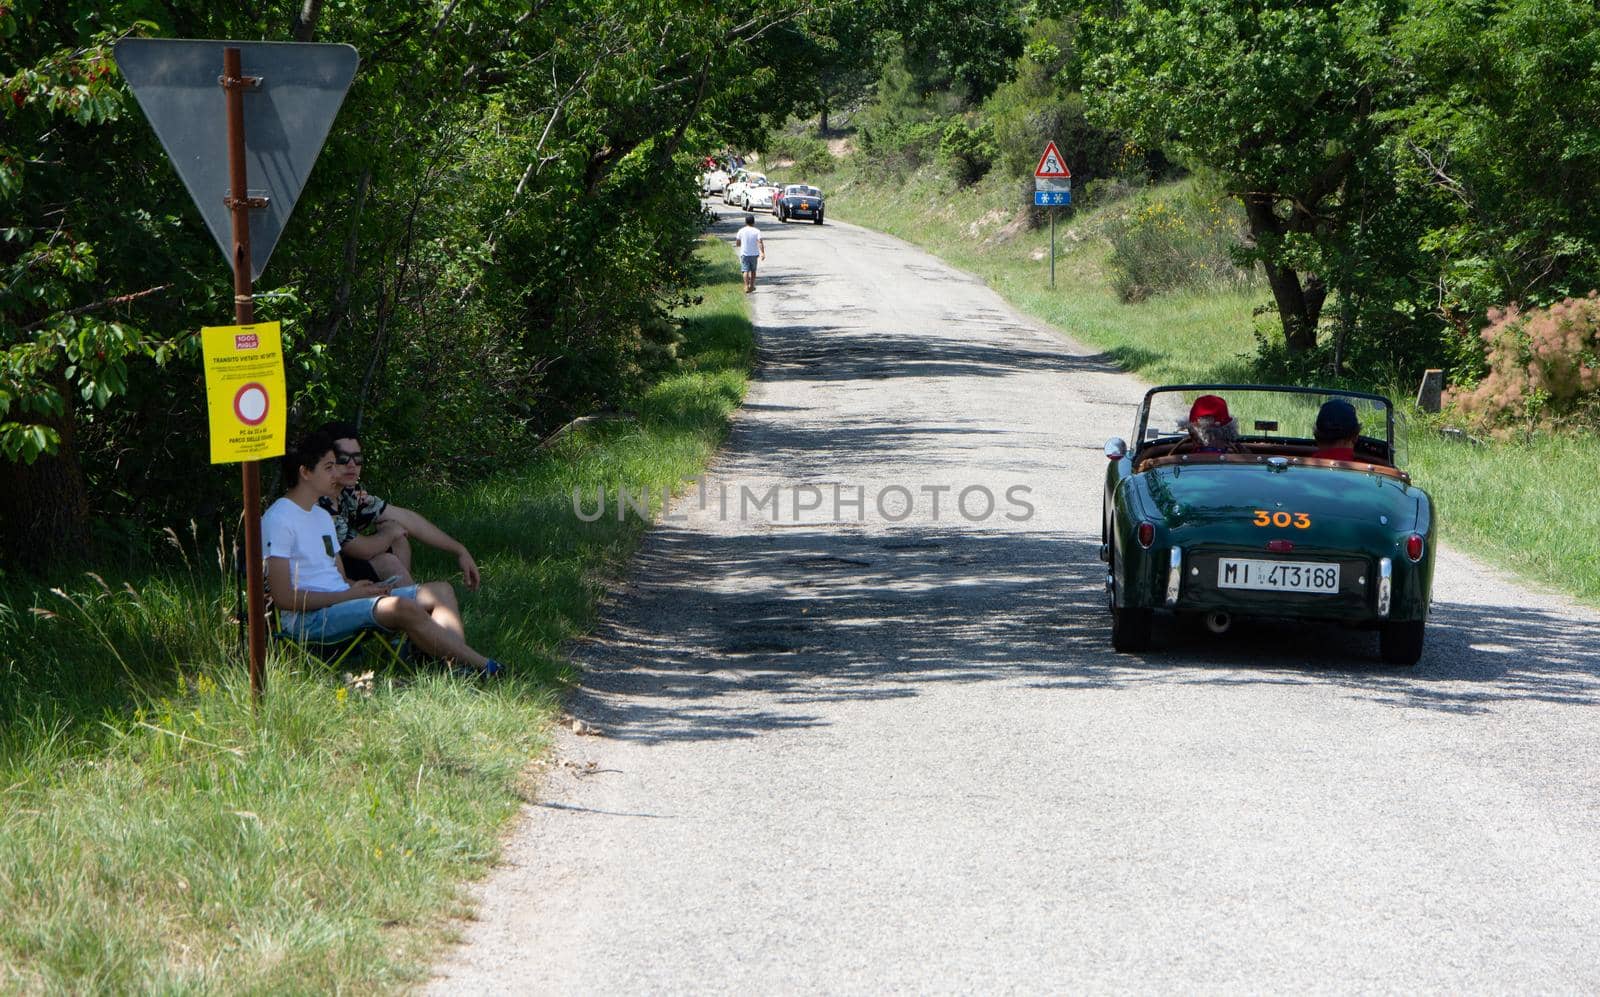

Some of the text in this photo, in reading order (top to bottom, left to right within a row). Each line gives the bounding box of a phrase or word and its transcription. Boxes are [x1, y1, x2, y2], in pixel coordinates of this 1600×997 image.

[1253, 510, 1311, 529] 303
[1225, 563, 1337, 588] MI 4T3168
